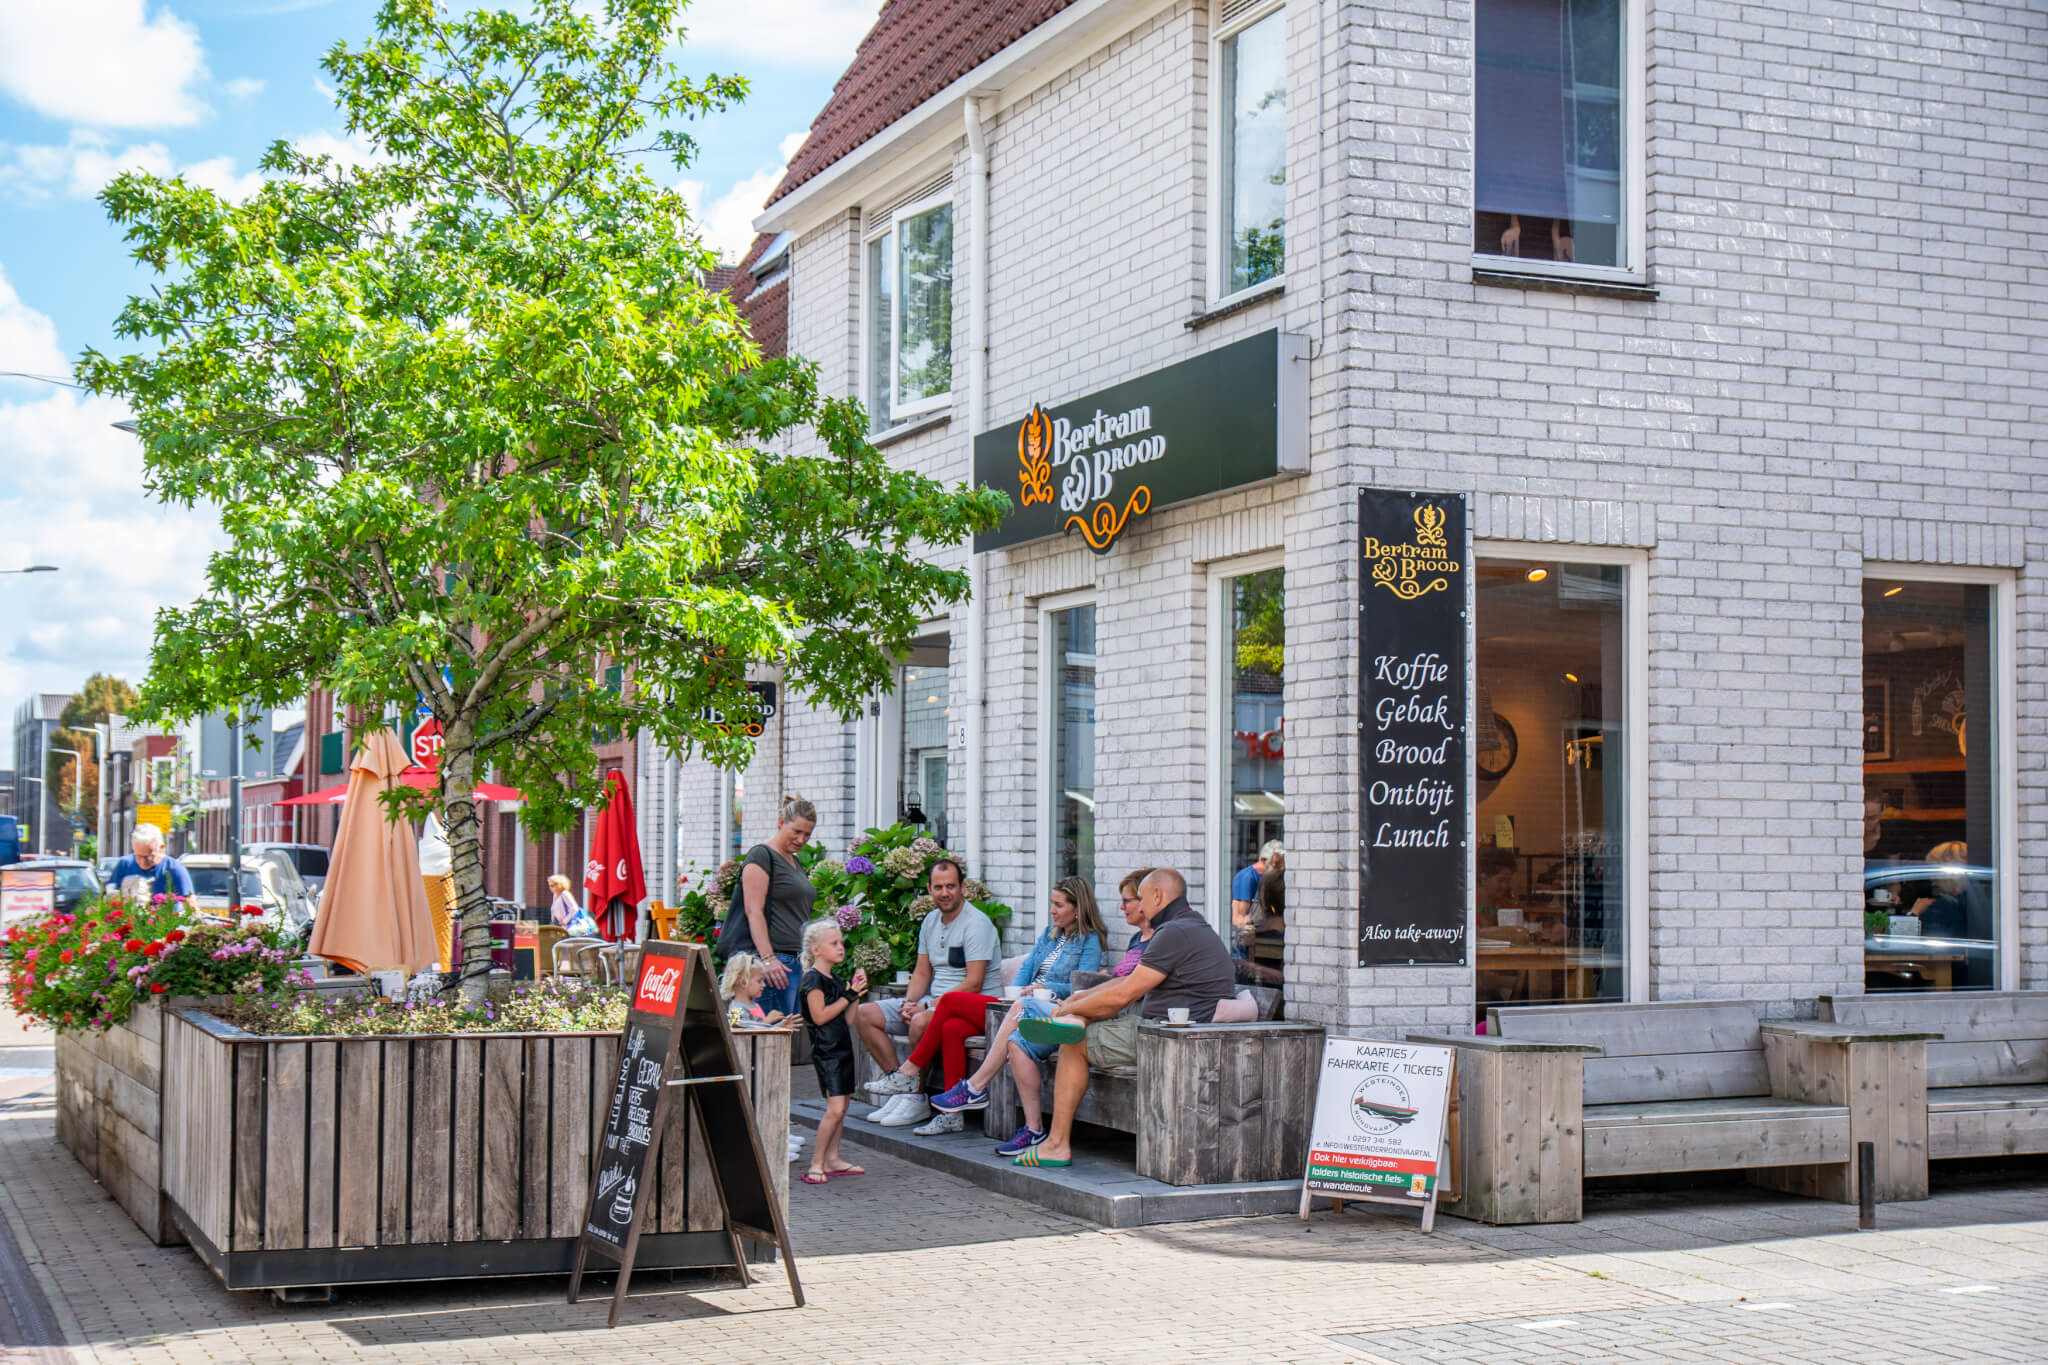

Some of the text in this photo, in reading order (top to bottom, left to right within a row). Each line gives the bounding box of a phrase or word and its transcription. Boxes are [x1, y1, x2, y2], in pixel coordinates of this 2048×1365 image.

[1052, 406, 1152, 467] Bertram
[1061, 455, 1091, 512] &
[1363, 537, 1448, 559] Bertram
[1372, 557, 1397, 581] &
[1374, 653, 1449, 690] Koffie
[1375, 695, 1454, 730] Gebak
[959, 727, 966, 744] 8
[1375, 736, 1452, 765] Brood
[1369, 777, 1454, 815] Ontbijt
[1372, 819, 1449, 847] Lunch
[1360, 923, 1464, 944] Also take-away!
[1356, 1045, 1408, 1059] KAARTJES
[1327, 1058, 1390, 1073] FAHRKARTE
[1403, 1063, 1444, 1077] TICKETS
[1352, 1135, 1371, 1143] 0297
[1314, 1152, 1331, 1161] Ook
[1332, 1155, 1348, 1163] hier
[1311, 1167, 1339, 1178] folders
[1340, 1170, 1383, 1181] historische
[1322, 1181, 1373, 1193] wandelroute
